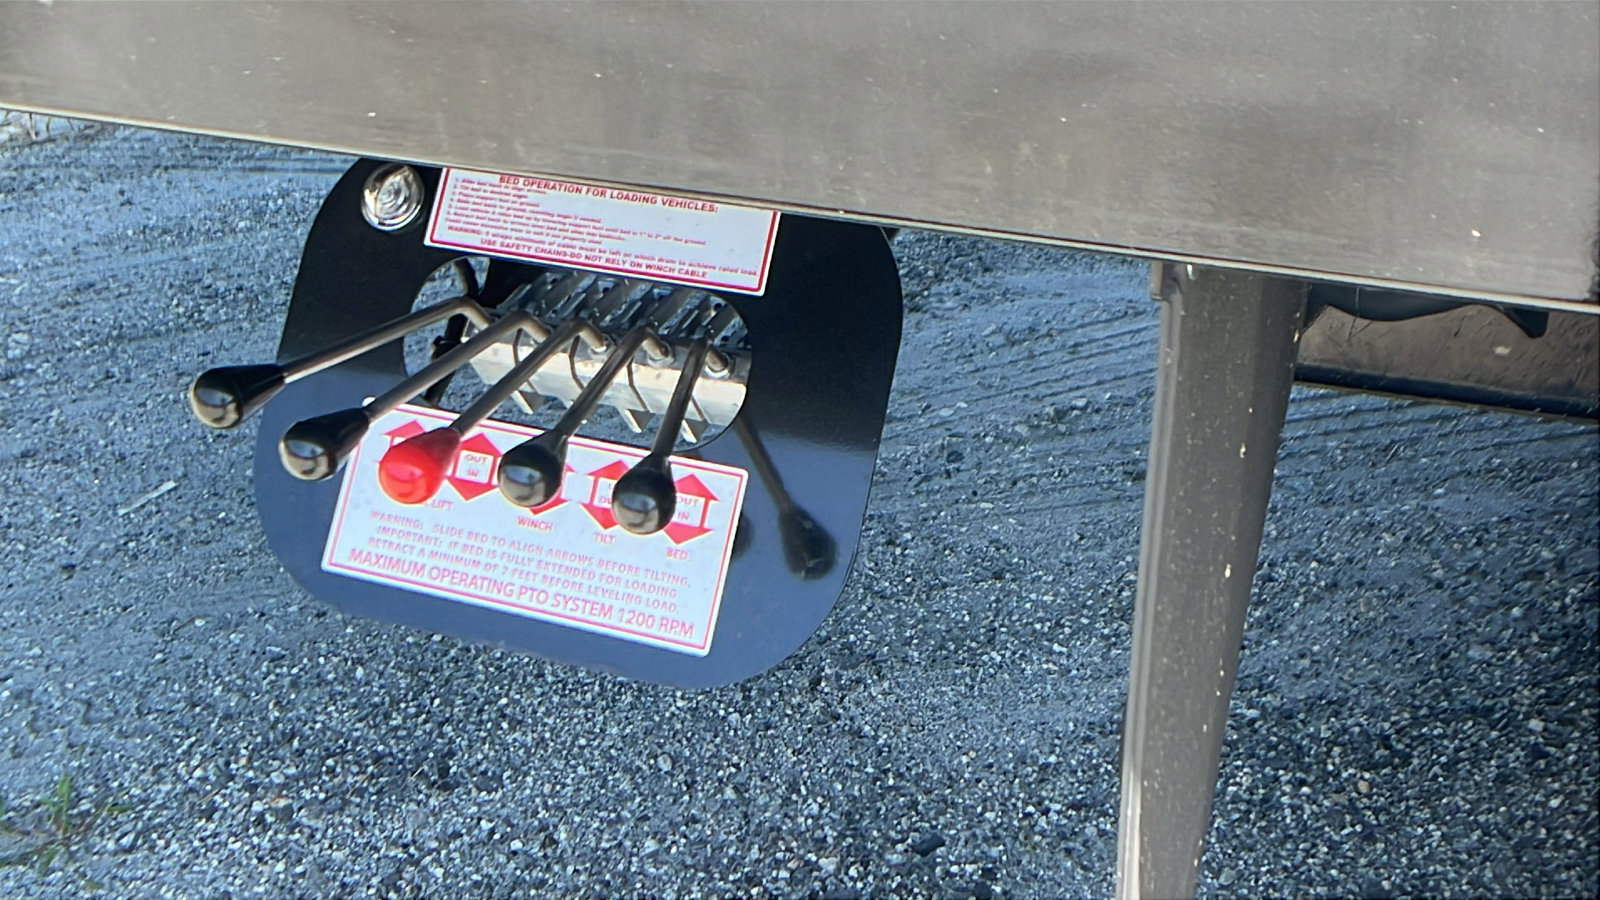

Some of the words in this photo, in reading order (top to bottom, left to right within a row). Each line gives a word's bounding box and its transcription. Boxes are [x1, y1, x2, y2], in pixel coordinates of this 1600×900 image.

[499, 175, 520, 185] BED
[523, 178, 583, 194] OPERATION
[586, 187, 607, 197] FOR
[610, 191, 657, 204] LOADING
[661, 198, 718, 213] VEHICLES:
[480, 237, 497, 246] USE
[499, 240, 532, 251] SAFETY
[585, 253, 603, 262] NOT
[606, 256, 627, 266] RELY
[630, 260, 642, 268] ON
[645, 262, 676, 273] WINCH
[678, 267, 707, 278] CABLE
[465, 453, 488, 463] OUT
[517, 516, 553, 531] WINCH
[678, 511, 690, 521] IN
[369, 510, 424, 529] WARNING:
[432, 524, 464, 537] SLIDE
[466, 531, 489, 543] BED
[491, 536, 506, 547] TO
[509, 540, 543, 554] ALIGN
[545, 548, 594, 566] ARROWS
[598, 559, 641, 576] BEFORE
[593, 532, 615, 544] TILT
[666, 547, 689, 560] BED
[367, 537, 416, 554] RETRACT
[417, 548, 426, 557] A
[429, 550, 481, 569] MINIMUM
[483, 562, 498, 573] OF
[501, 566, 509, 575] 7
[511, 568, 539, 582] FEET
[541, 575, 584, 592] BEFORE
[587, 585, 642, 604] LEVELING
[645, 598, 680, 613] LOAD.
[376, 525, 443, 546] IMPORTANT:
[449, 541, 458, 549] IF
[461, 543, 484, 555] BED
[487, 549, 497, 558] IS
[500, 552, 534, 566] FULLY
[536, 560, 596, 579] EXTENDED
[599, 573, 622, 585] FOR
[625, 579, 678, 597] LOADING
[348, 548, 426, 577] MAXIMUM
[427, 565, 515, 597] OPERATING
[517, 585, 549, 604] PTO
[551, 593, 614, 619] SYSTEM
[616, 607, 656, 628] 1200
